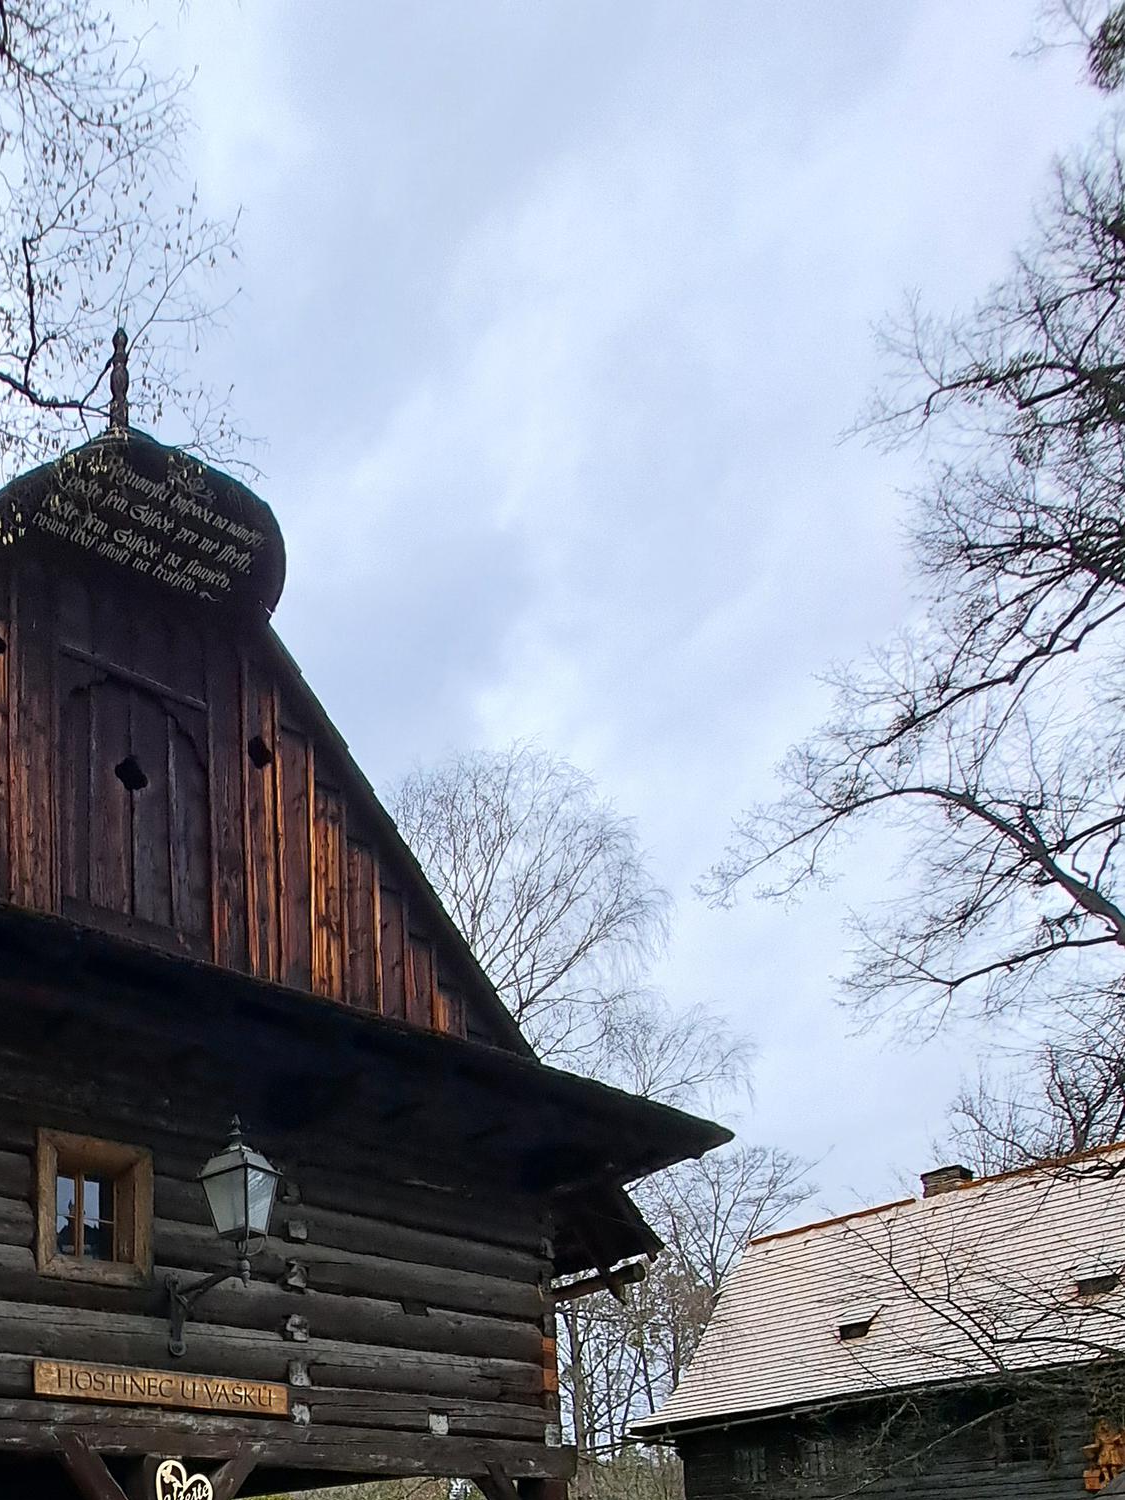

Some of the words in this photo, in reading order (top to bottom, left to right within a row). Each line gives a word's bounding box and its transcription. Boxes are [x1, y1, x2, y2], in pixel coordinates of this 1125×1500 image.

[172, 526, 200, 545] pro
[132, 557, 151, 572] na
[163, 551, 182, 568] na
[57, 1368, 173, 1399] HOSTINEC
[180, 1381, 197, 1400] U
